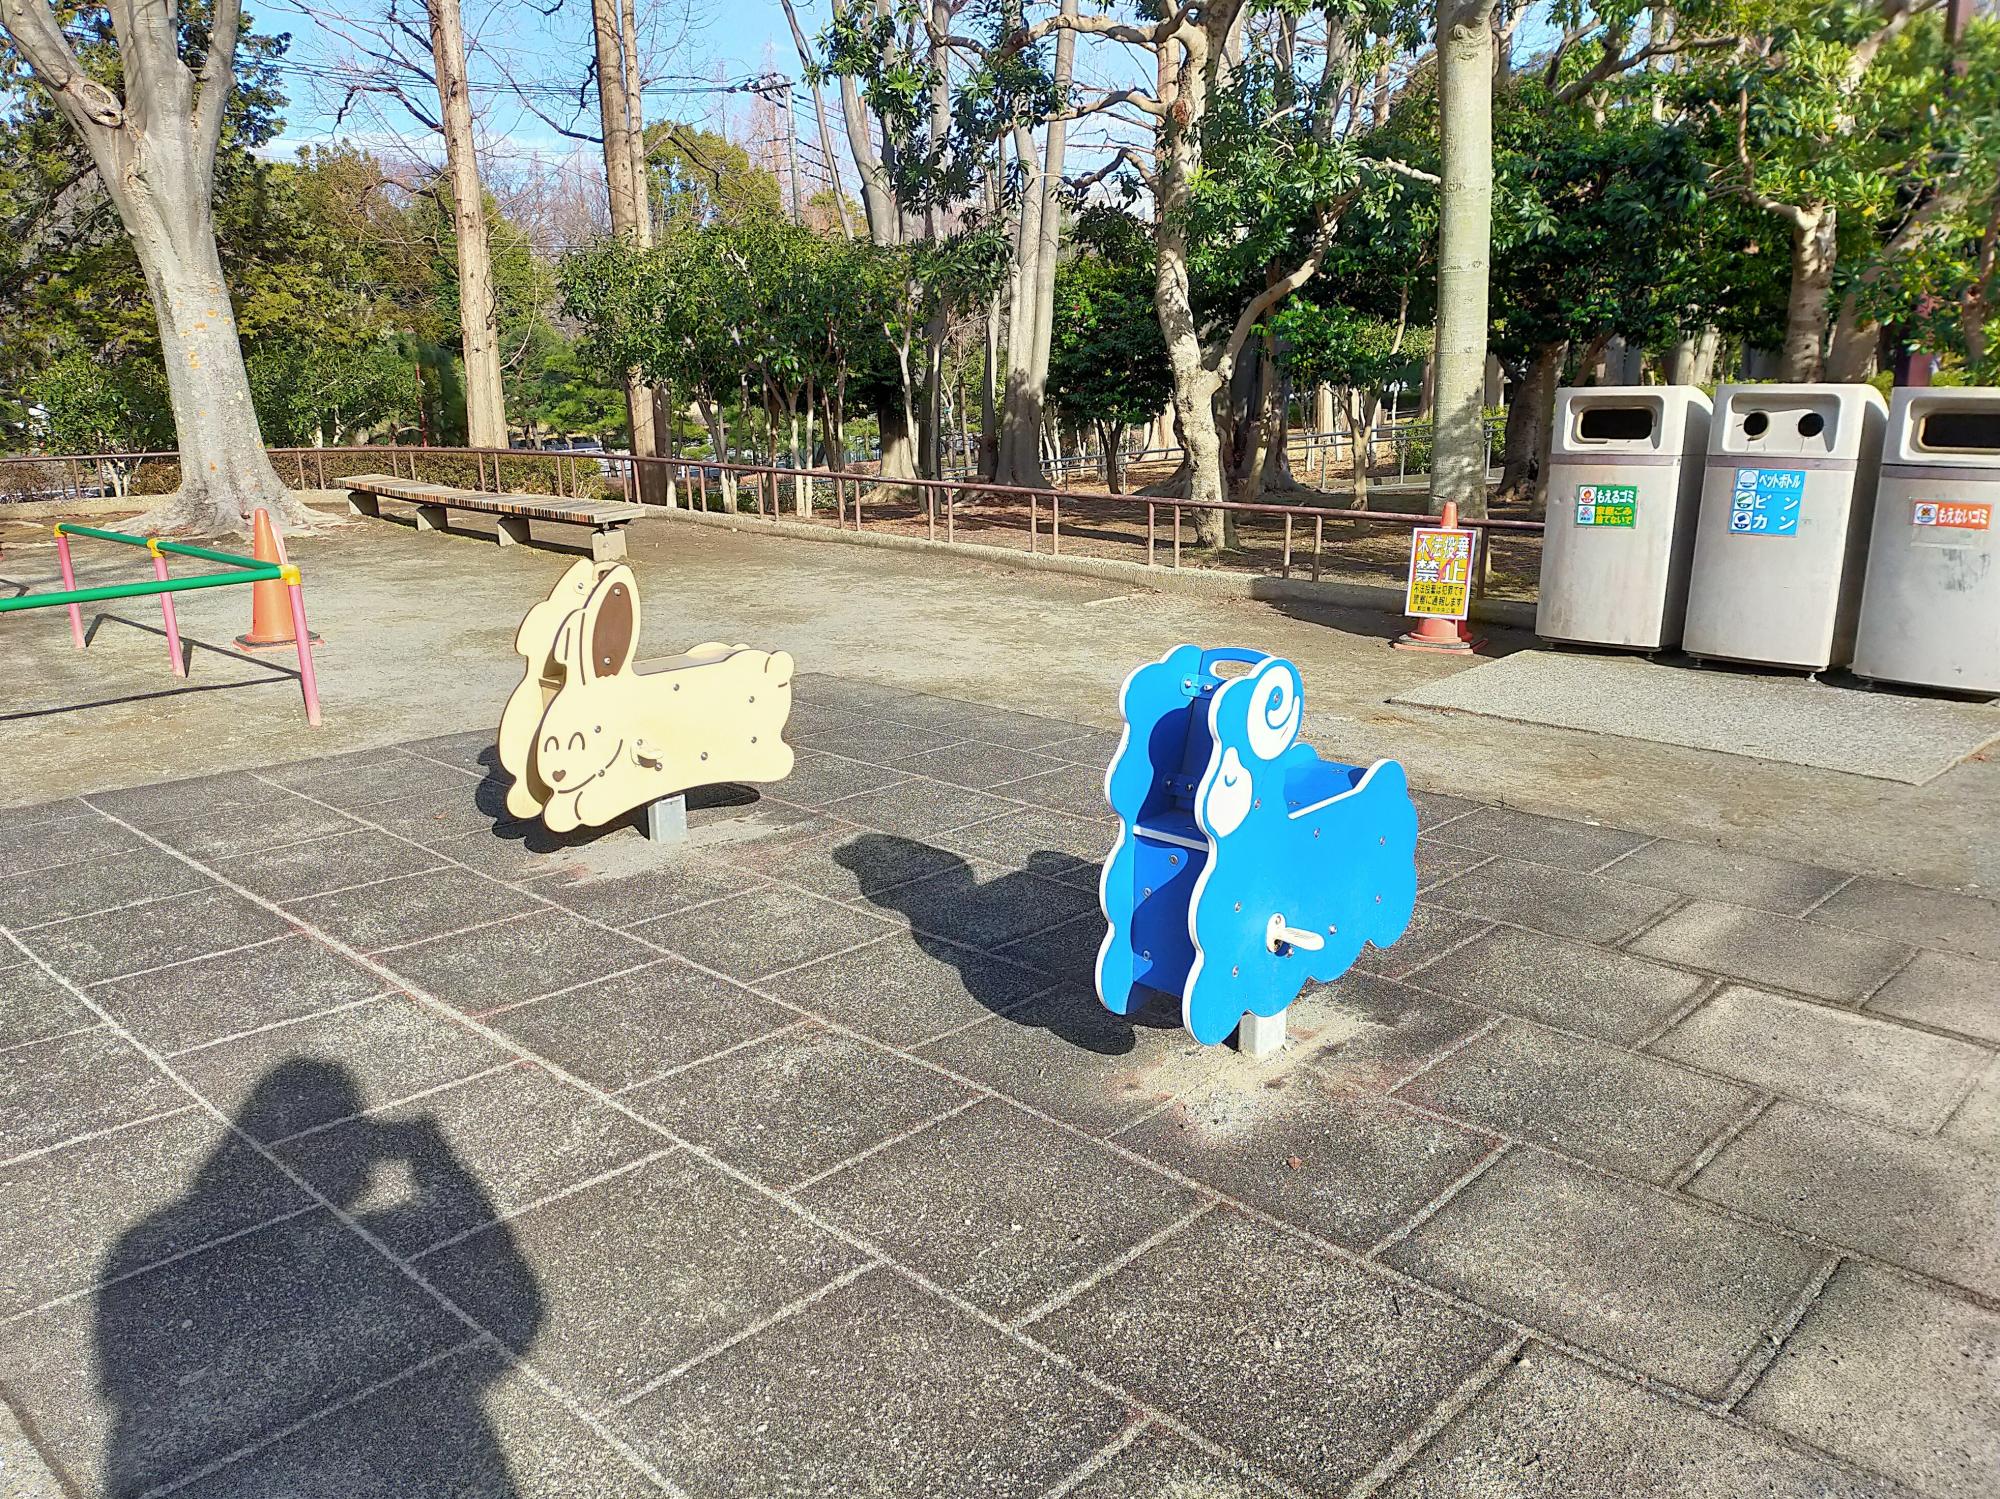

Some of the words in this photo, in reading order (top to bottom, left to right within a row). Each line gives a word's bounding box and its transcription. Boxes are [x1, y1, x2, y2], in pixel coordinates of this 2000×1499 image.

[1759, 473, 1801, 488] ペットボトル
[1597, 489, 1634, 503] もえるゴミ
[1938, 507, 1988, 524] もえないゴミ
[1417, 534, 1470, 560] 不法投棄
[1415, 559, 1466, 583] 禁止
